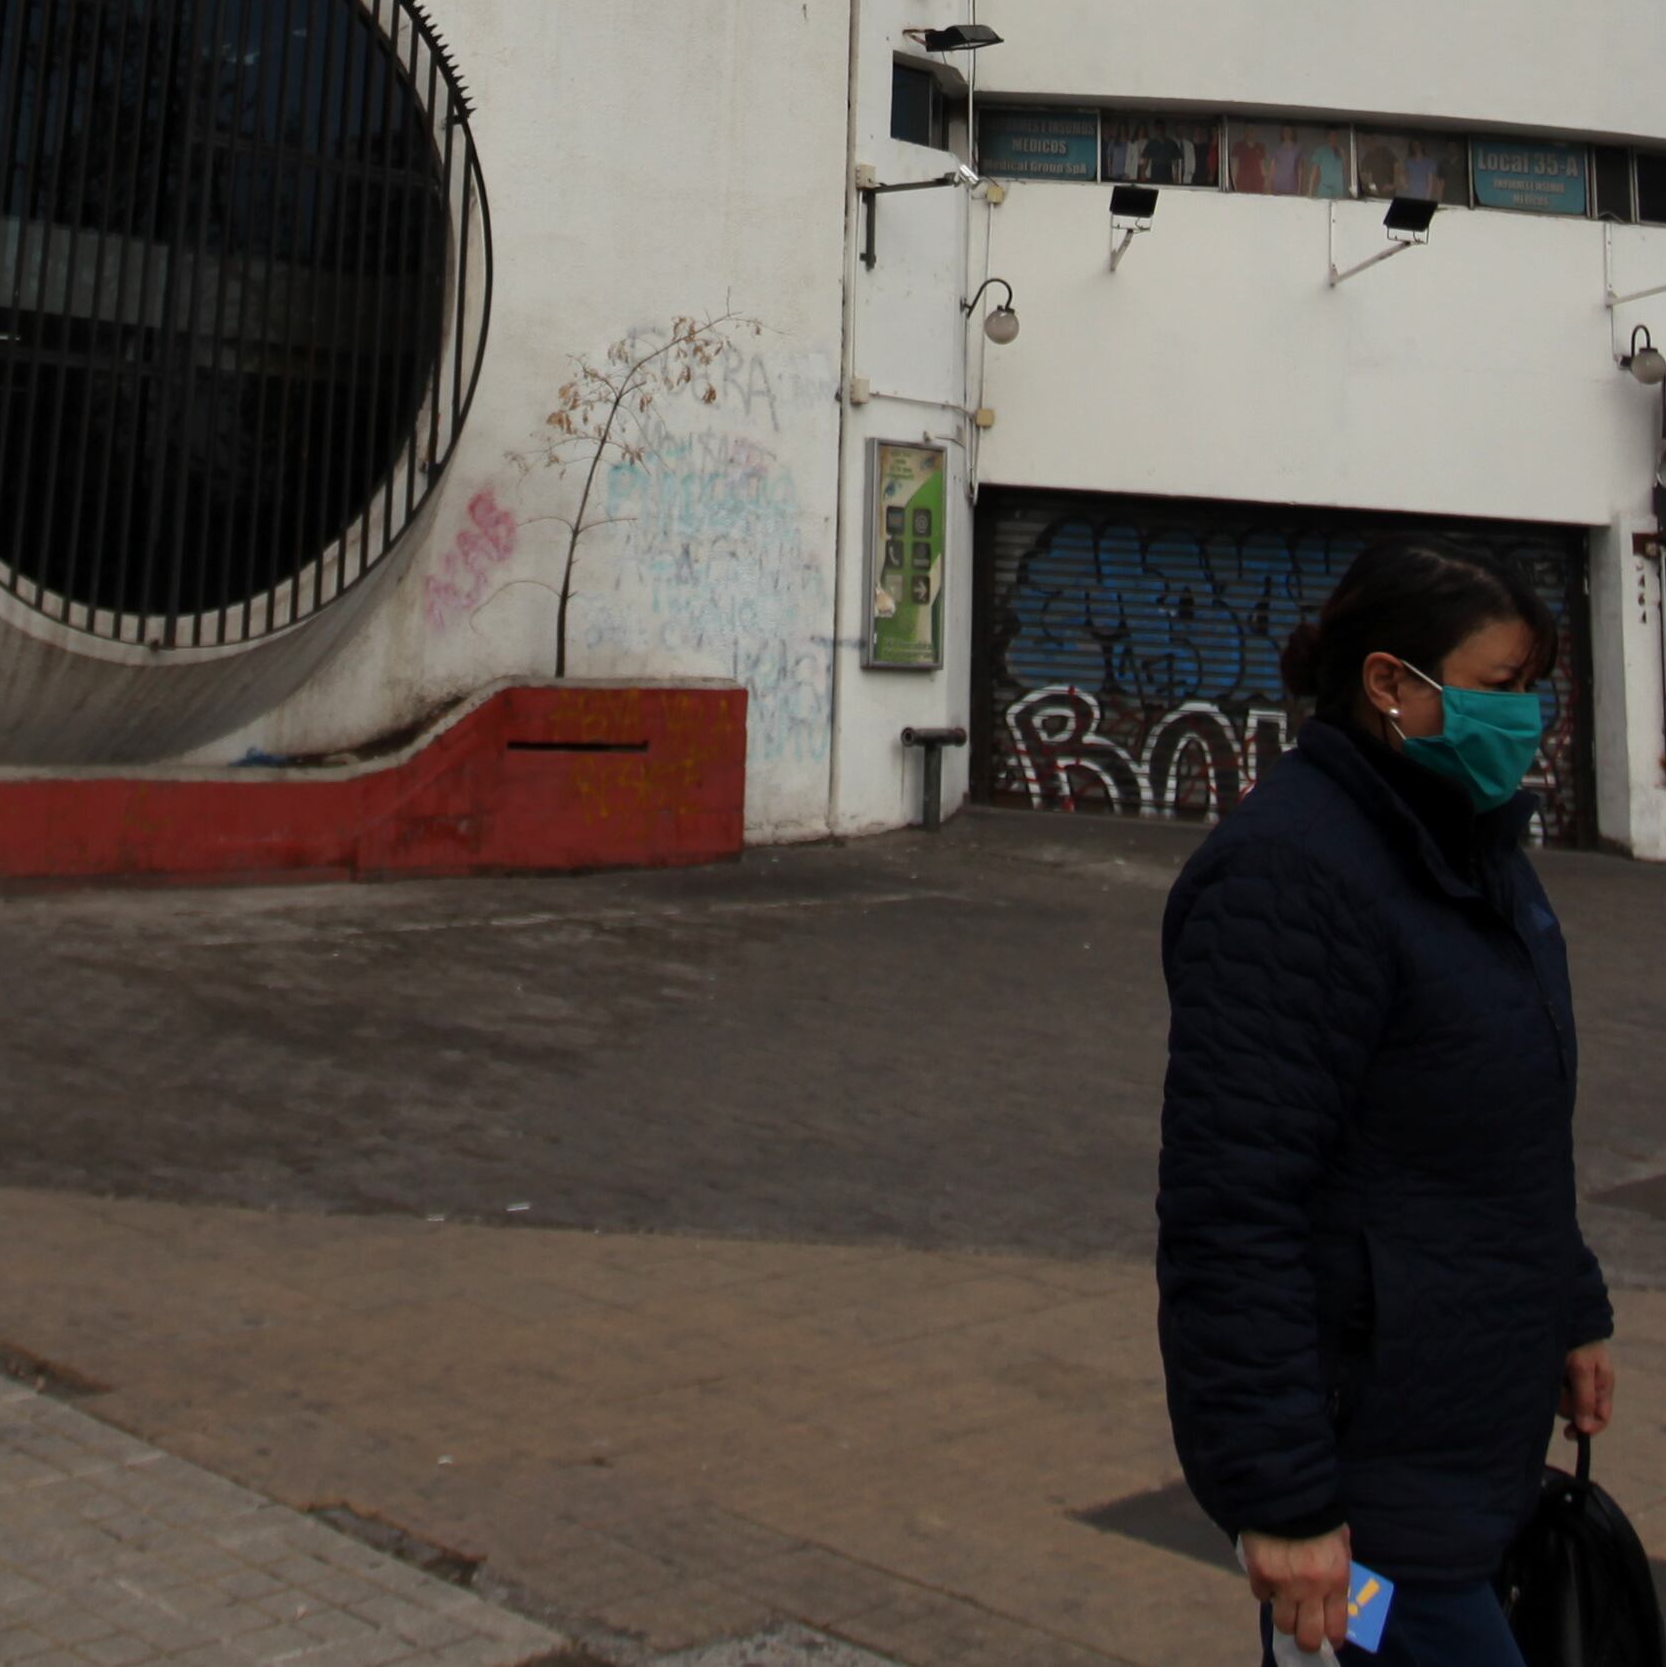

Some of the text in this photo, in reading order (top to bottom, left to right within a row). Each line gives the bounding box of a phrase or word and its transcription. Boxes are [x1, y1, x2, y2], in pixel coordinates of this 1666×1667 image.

[1030, 160, 1063, 175] Group
[1065, 162, 1087, 175] SpA
[1478, 147, 1579, 177] Local 35-A
